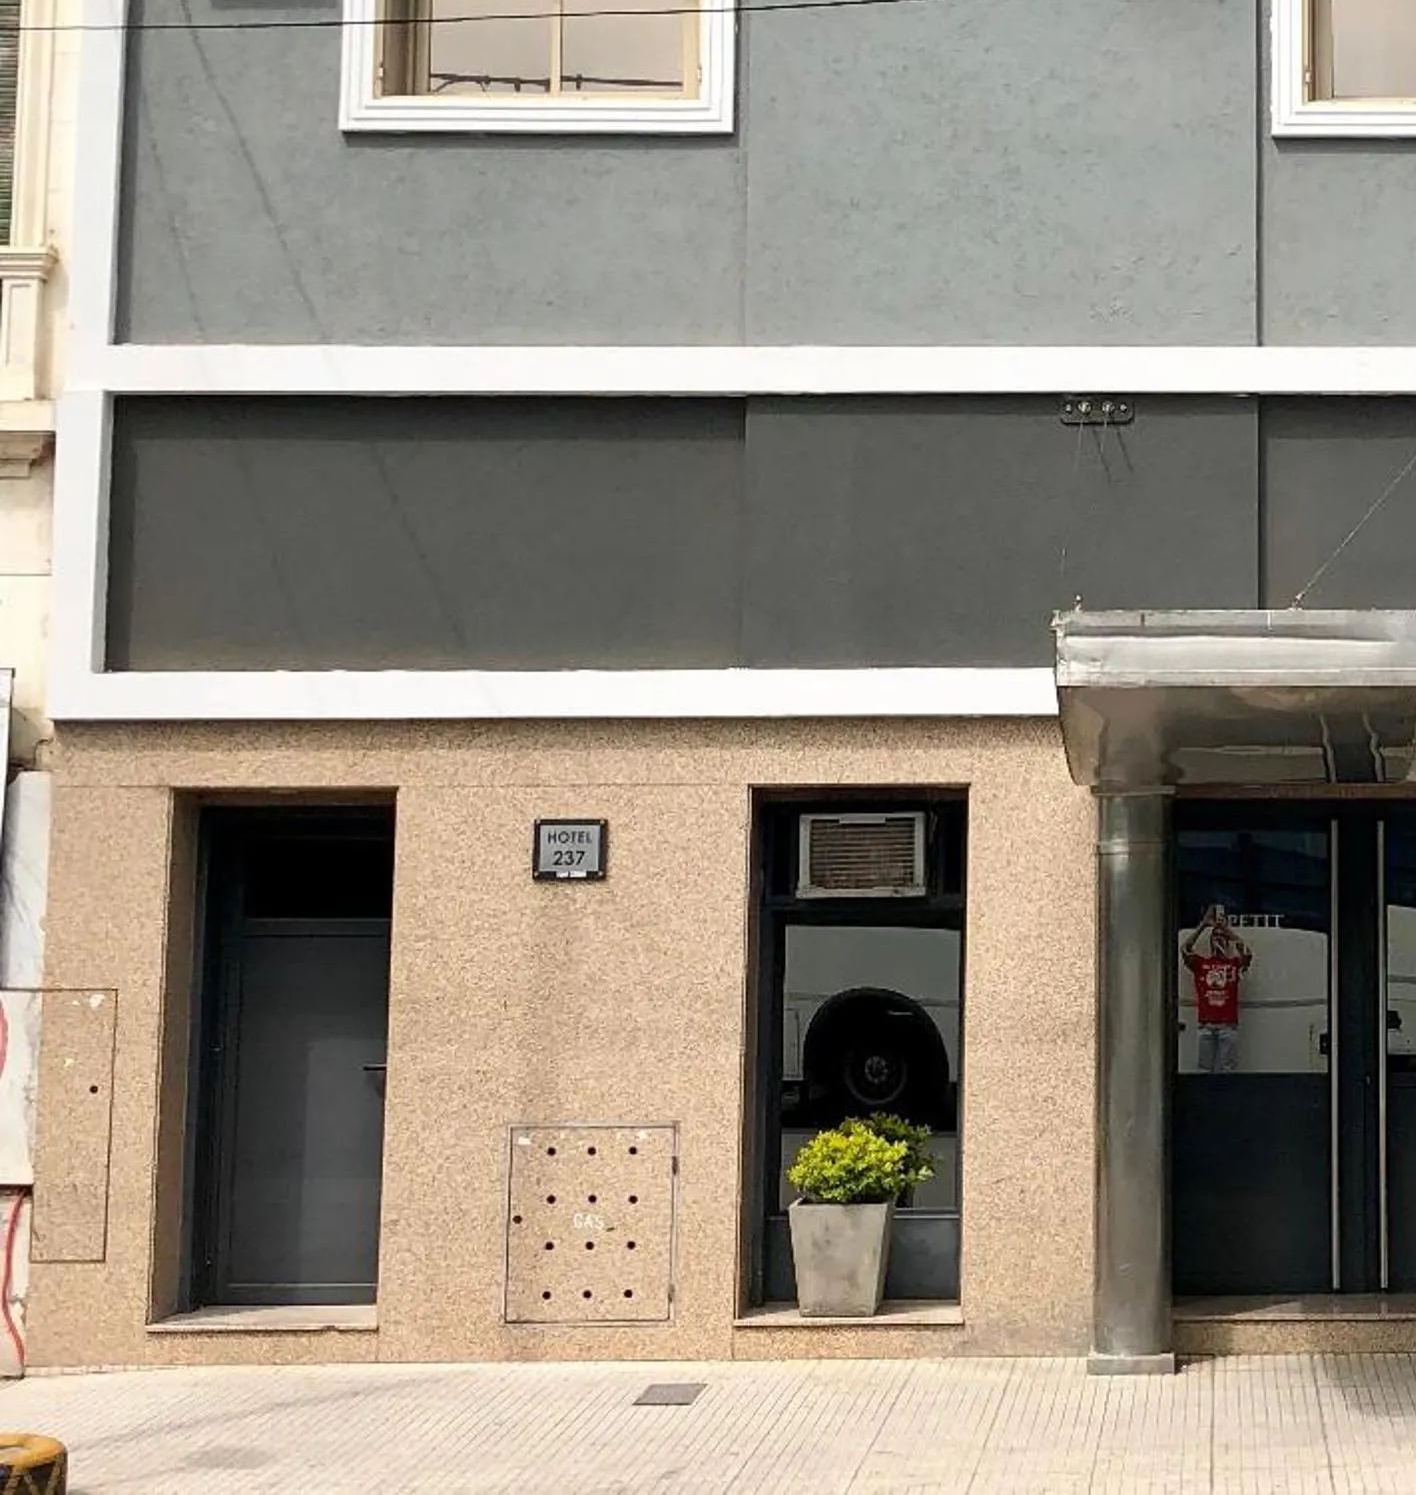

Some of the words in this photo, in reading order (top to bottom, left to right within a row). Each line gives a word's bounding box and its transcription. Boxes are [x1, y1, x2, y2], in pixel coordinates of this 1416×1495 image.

[547, 830, 593, 844] HOTEL
[552, 850, 586, 866] 237
[570, 1213, 605, 1230] GAS
